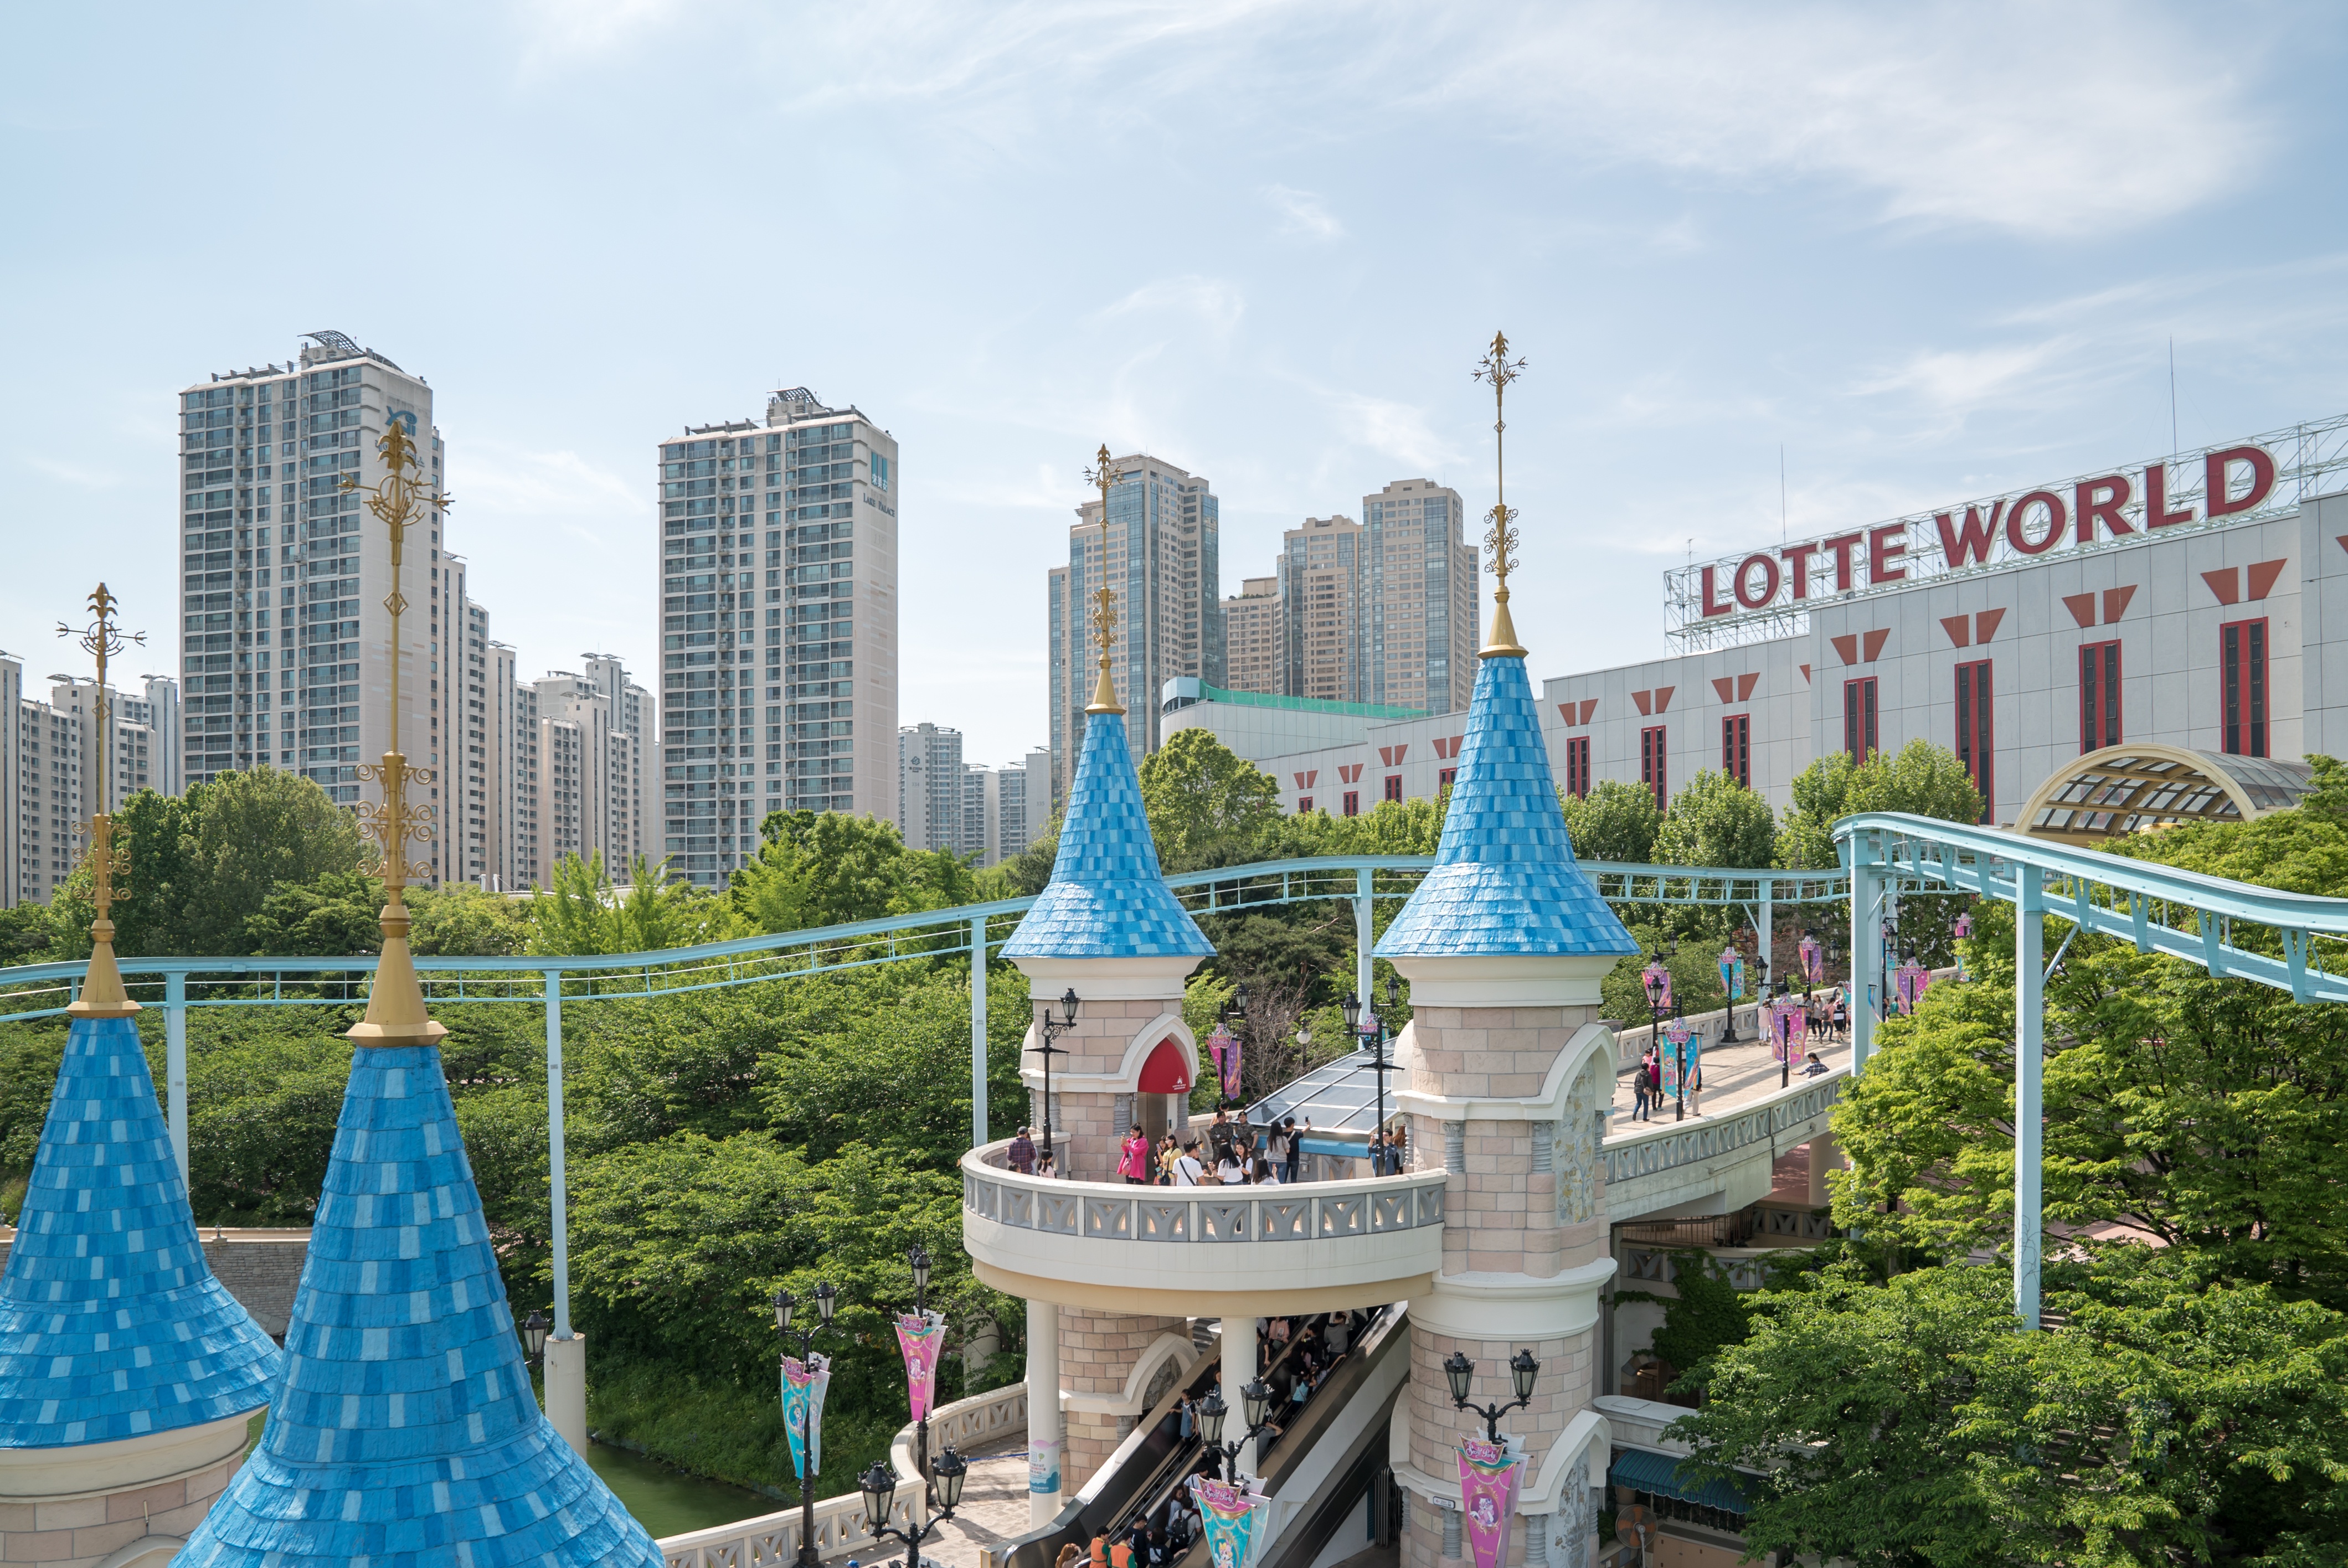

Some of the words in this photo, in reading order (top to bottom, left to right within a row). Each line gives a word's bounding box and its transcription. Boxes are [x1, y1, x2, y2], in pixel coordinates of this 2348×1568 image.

[863, 492, 876, 508] LAKE
[878, 501, 895, 518] PALACE
[1701, 520, 1909, 620] LOTTE
[1932, 445, 2279, 571] WORLD
[1481, 1448, 1496, 1460] Party
[1219, 1490, 1233, 1504] Party
